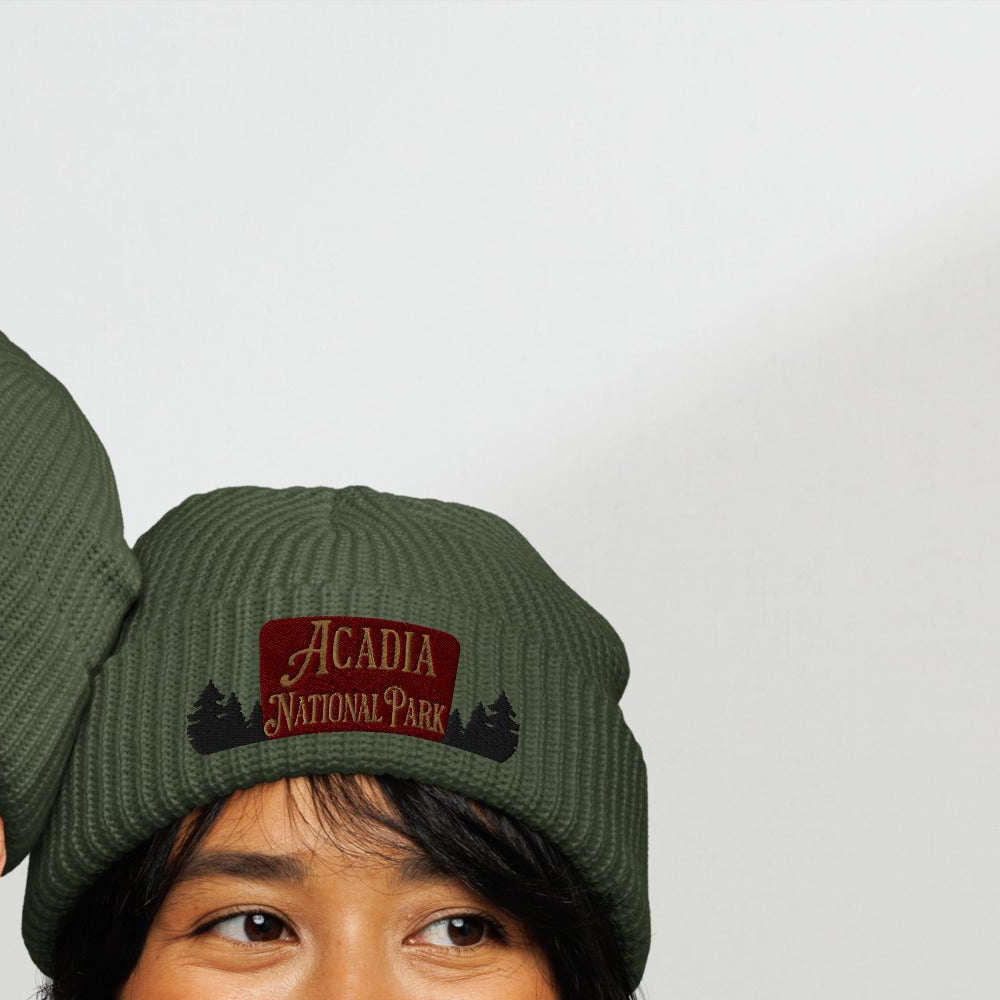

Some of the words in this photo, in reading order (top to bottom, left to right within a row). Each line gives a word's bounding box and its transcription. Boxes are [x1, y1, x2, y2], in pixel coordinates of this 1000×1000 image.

[279, 619, 437, 688] ACADIA
[264, 691, 383, 737] NATIONAL
[384, 685, 447, 735] PARK
